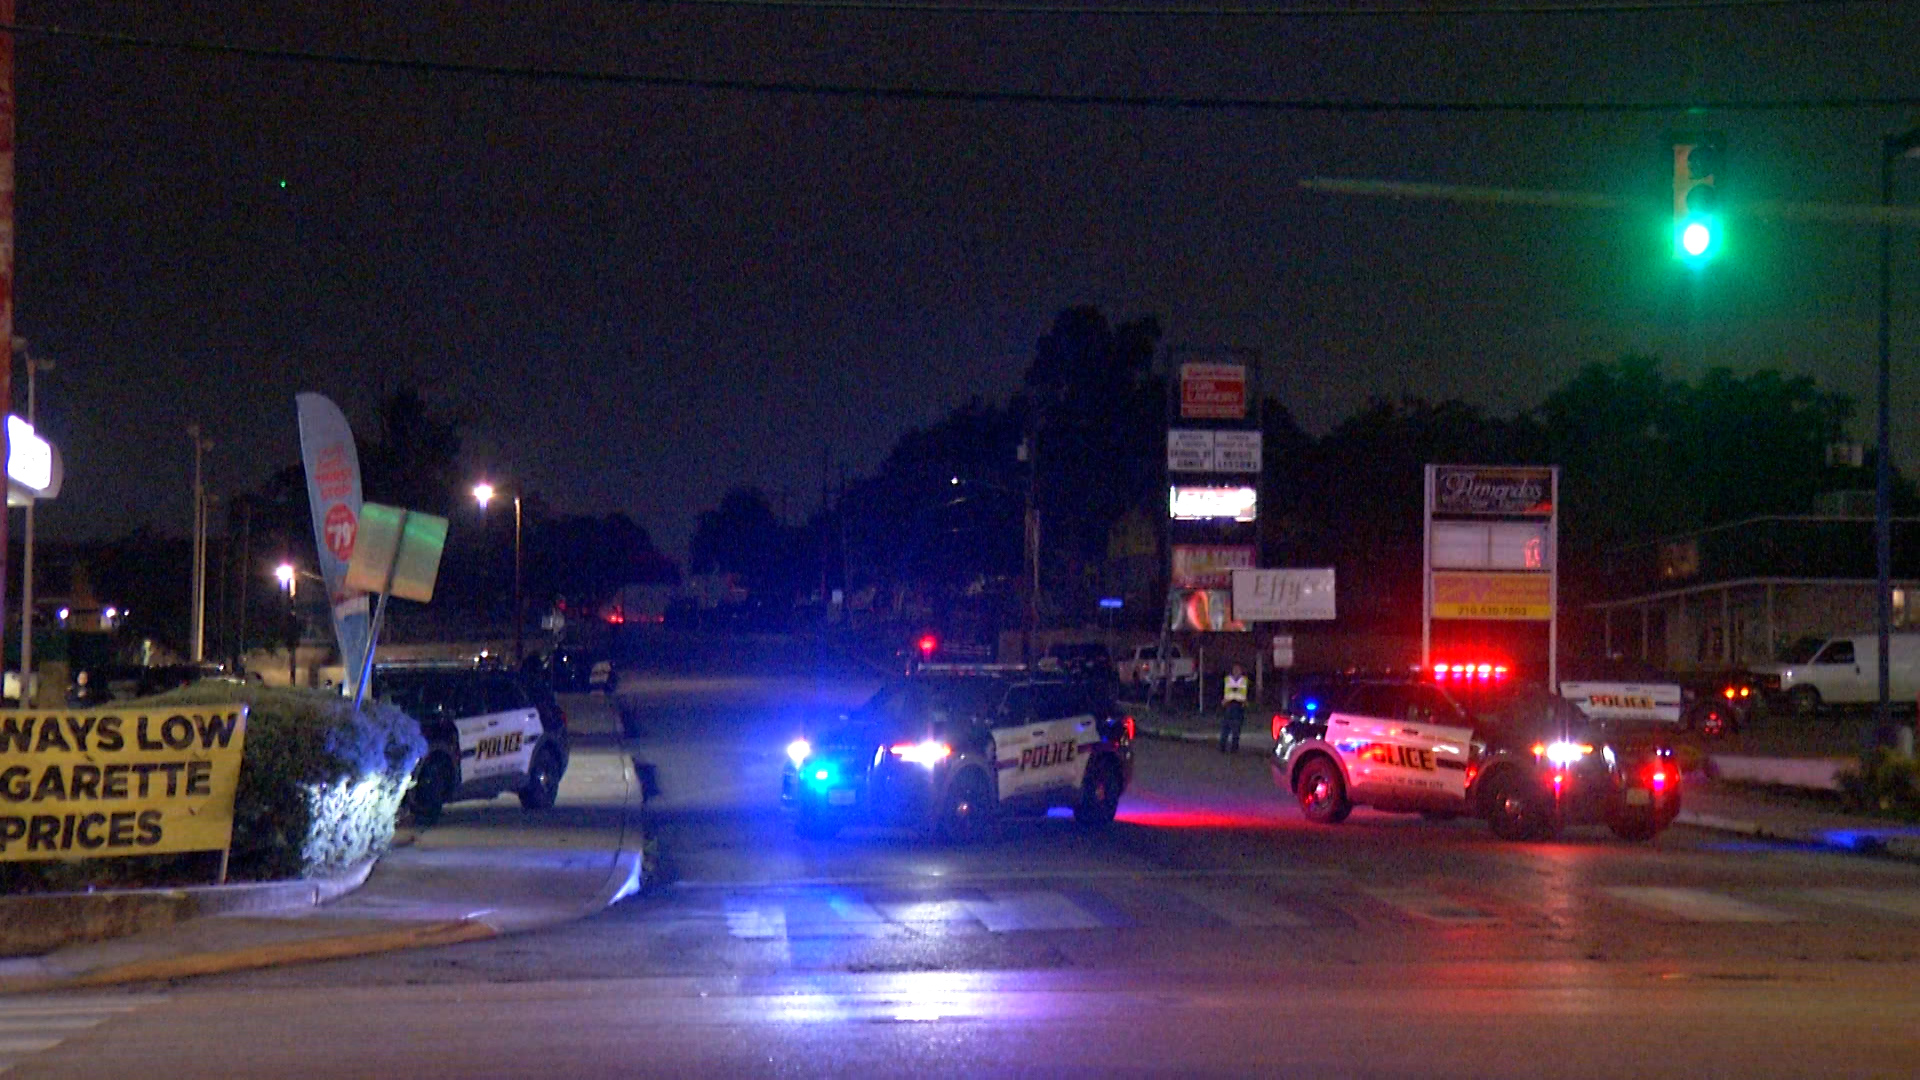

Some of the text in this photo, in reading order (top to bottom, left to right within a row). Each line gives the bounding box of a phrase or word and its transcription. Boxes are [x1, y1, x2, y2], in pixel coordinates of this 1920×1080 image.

[1589, 694, 1653, 709] POLICE
[137, 713, 239, 750] LOW
[475, 731, 524, 760] POLICE
[1020, 738, 1078, 772] POLICE
[0, 760, 212, 802] GARETTE
[0, 809, 163, 851] PRICES
